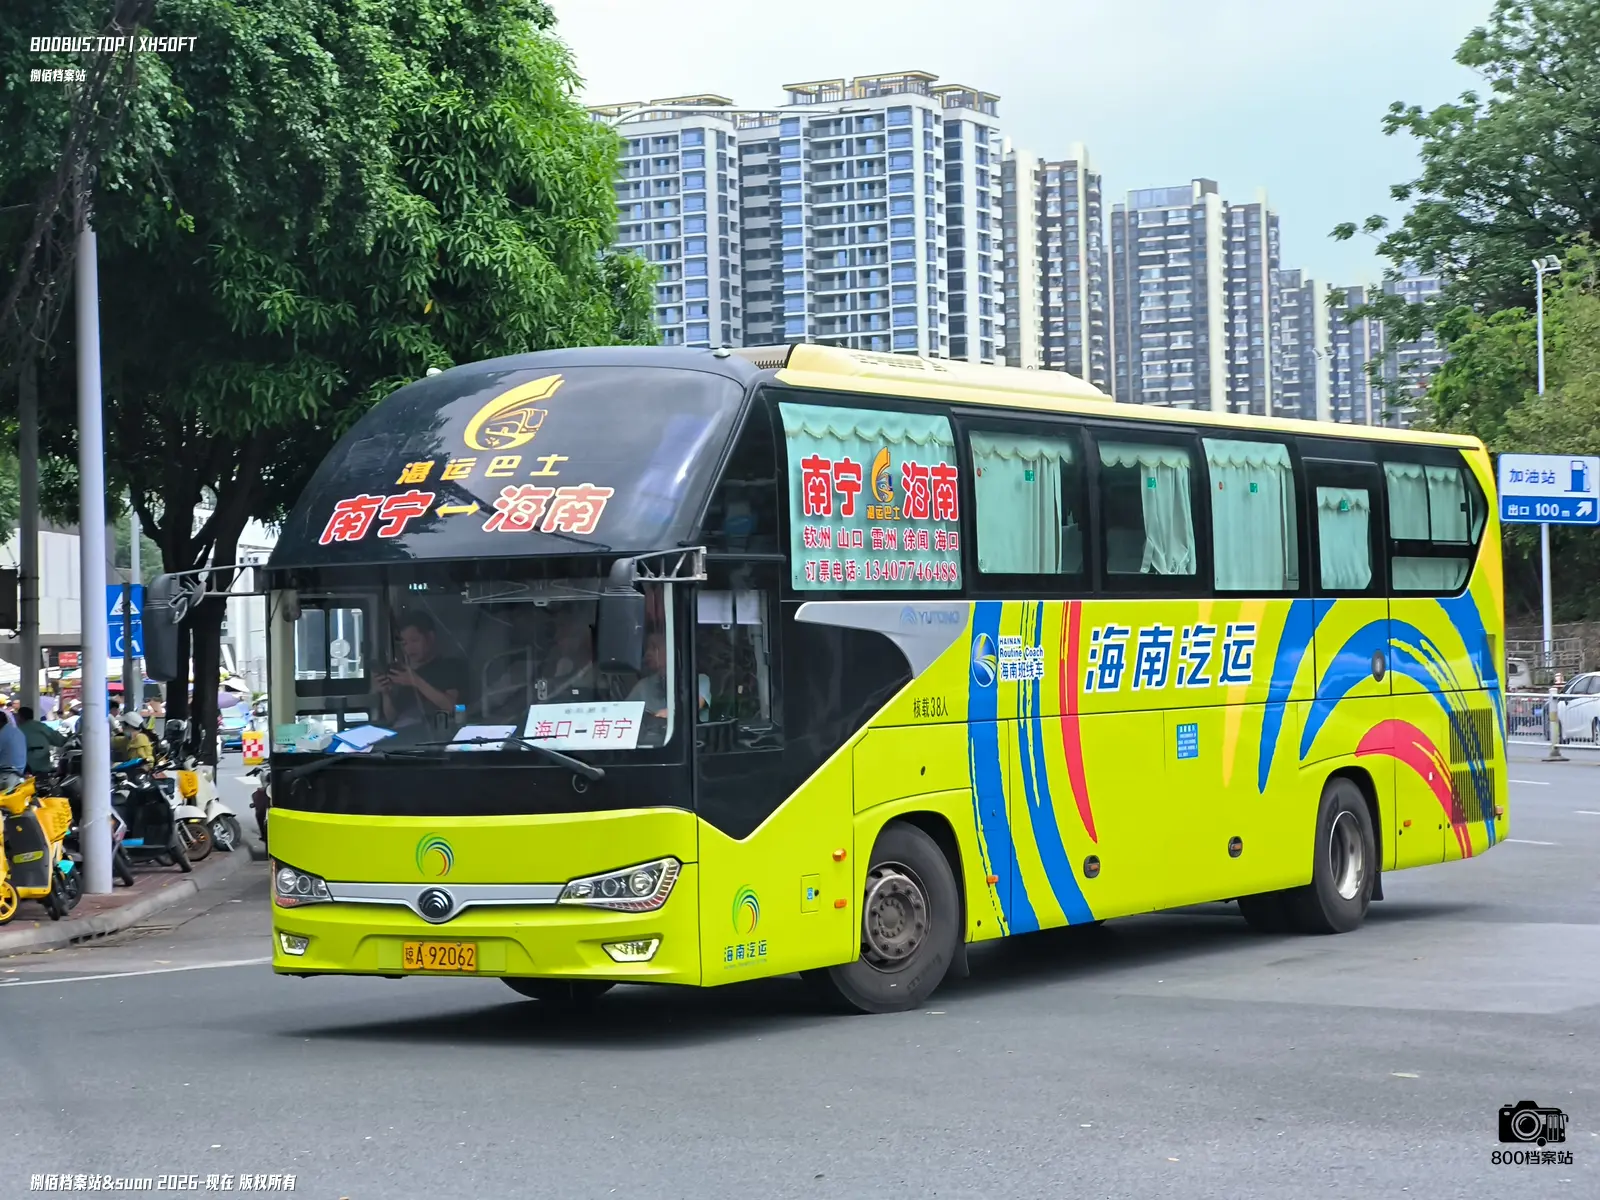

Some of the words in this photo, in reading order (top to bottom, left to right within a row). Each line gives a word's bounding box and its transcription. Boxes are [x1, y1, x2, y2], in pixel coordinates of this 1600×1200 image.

[801, 454, 863, 518] 南宁
[901, 461, 959, 521] 海南
[1509, 469, 1556, 484] 加油站
[319, 489, 435, 545] 南宁
[482, 483, 614, 534] 海南
[1508, 504, 1530, 516] 出口
[1535, 503, 1559, 517] 100
[803, 526, 832, 549] 钦州
[837, 528, 863, 548] 山口
[871, 527, 898, 551] 雷州
[903, 528, 929, 551] 徐闻
[935, 529, 959, 551] 海口
[999, 637, 1021, 645] HAINAN
[1000, 647, 1022, 657] Routine
[1025, 647, 1044, 657] Coach
[1083, 623, 1257, 693] 海南汽运
[1000, 662, 1044, 680] 海南班线车
[913, 696, 949, 718] 核载38人
[724, 939, 768, 962] 海南汽运
